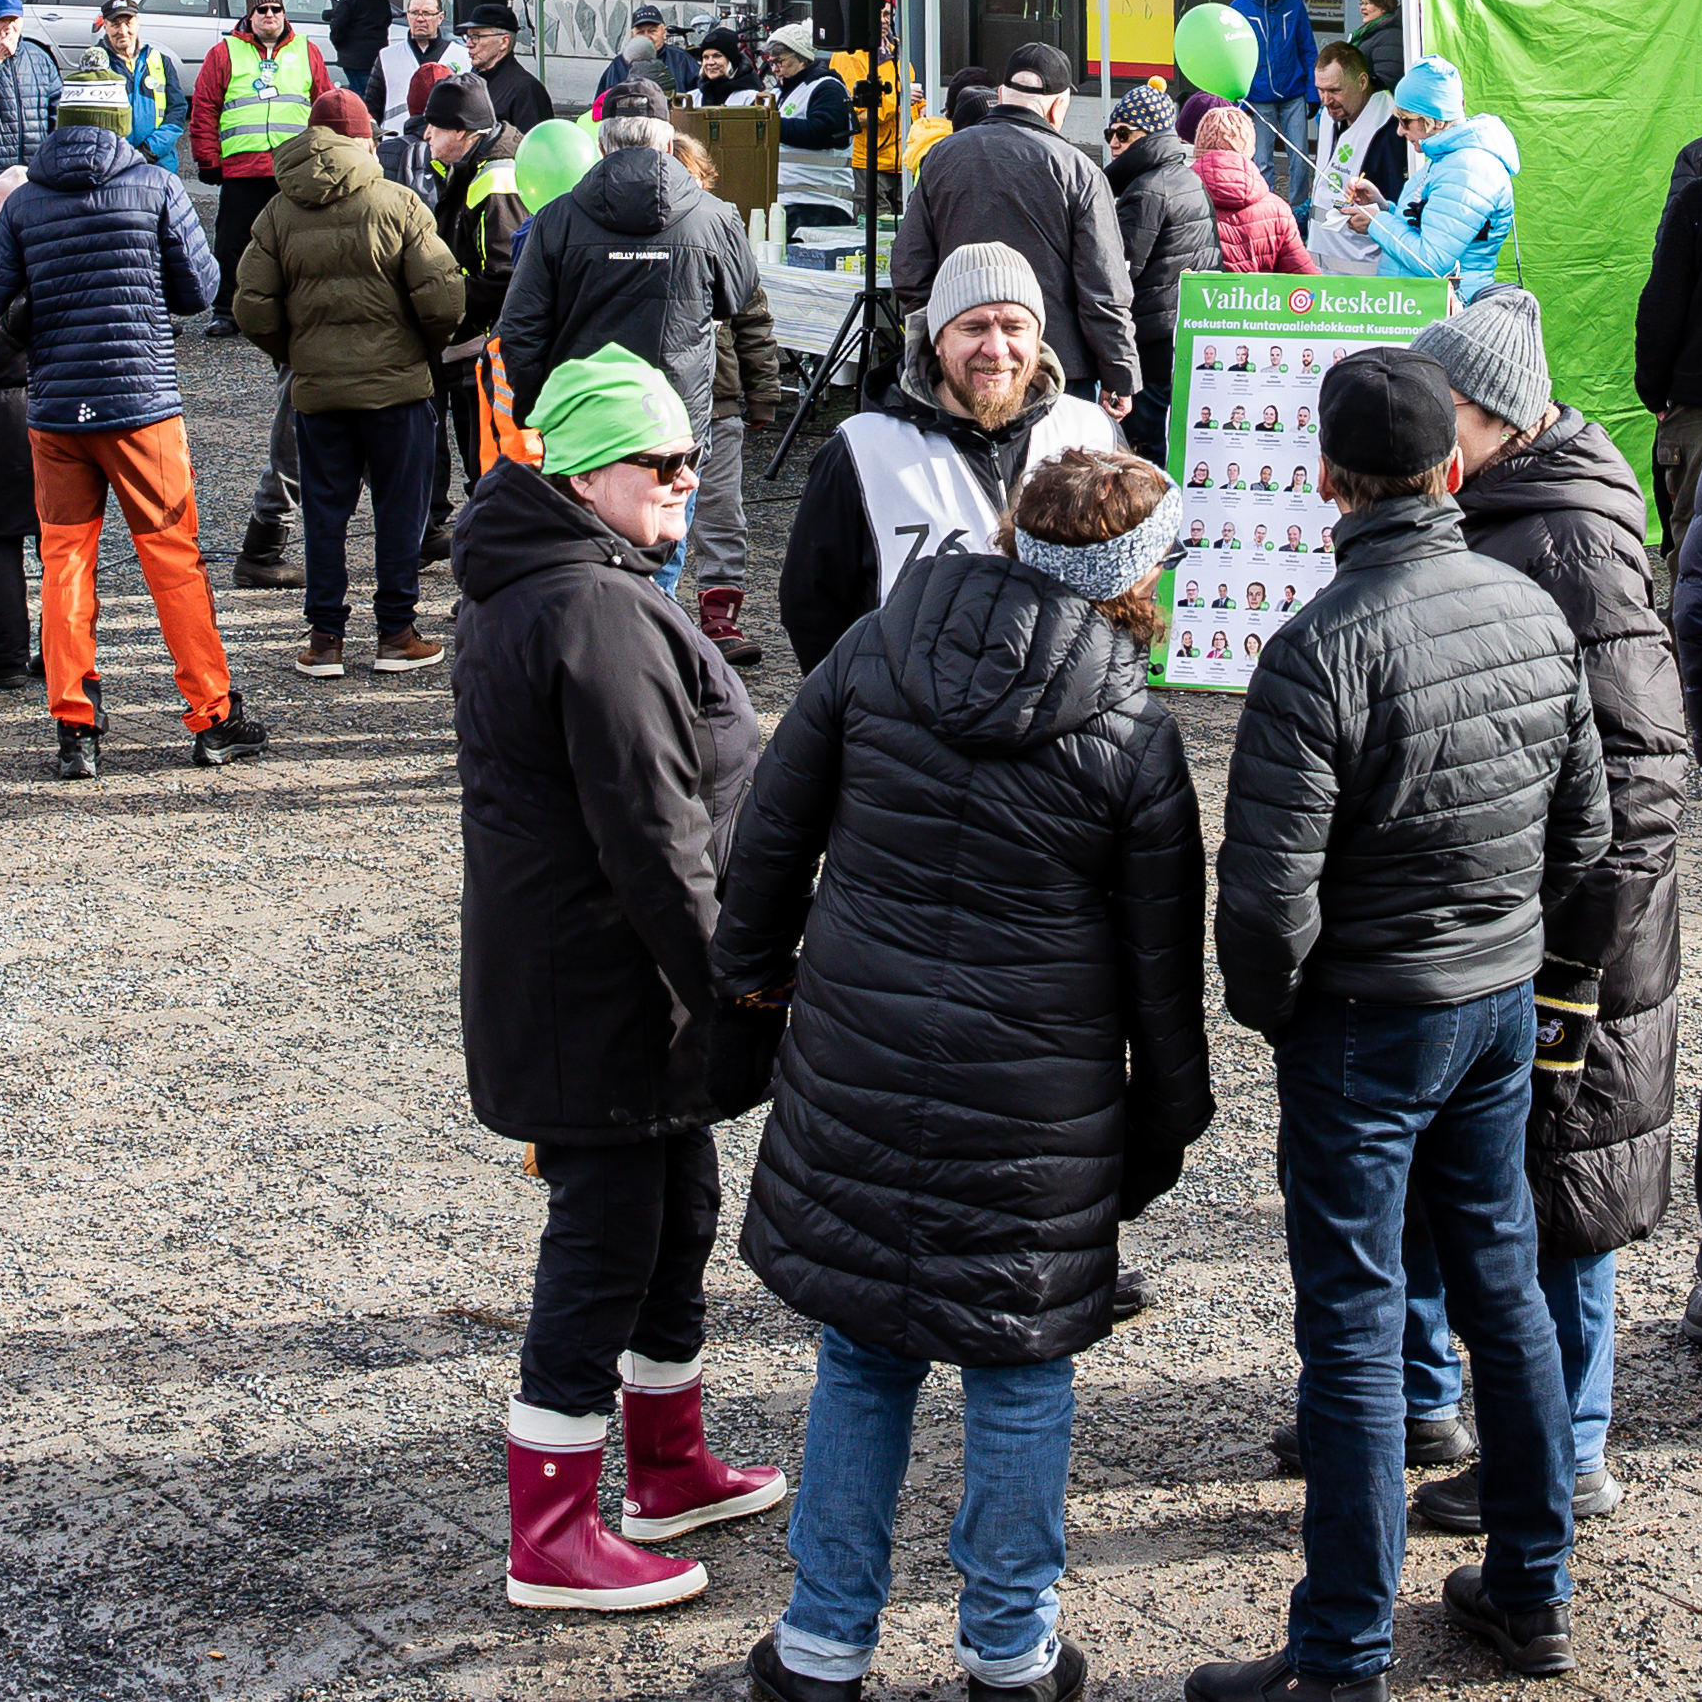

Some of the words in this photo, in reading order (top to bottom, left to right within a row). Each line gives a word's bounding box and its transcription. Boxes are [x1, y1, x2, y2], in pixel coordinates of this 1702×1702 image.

[608, 251, 634, 259] HELLY
[636, 251, 669, 260] HANSEN
[1201, 287, 1282, 311] Vaihda
[1319, 289, 1423, 316] keskelle.
[1183, 318, 1241, 331] Keskustan
[1242, 319, 1365, 335] kuntavaaliehdokkaat
[1366, 323, 1424, 336] Kuusamos
